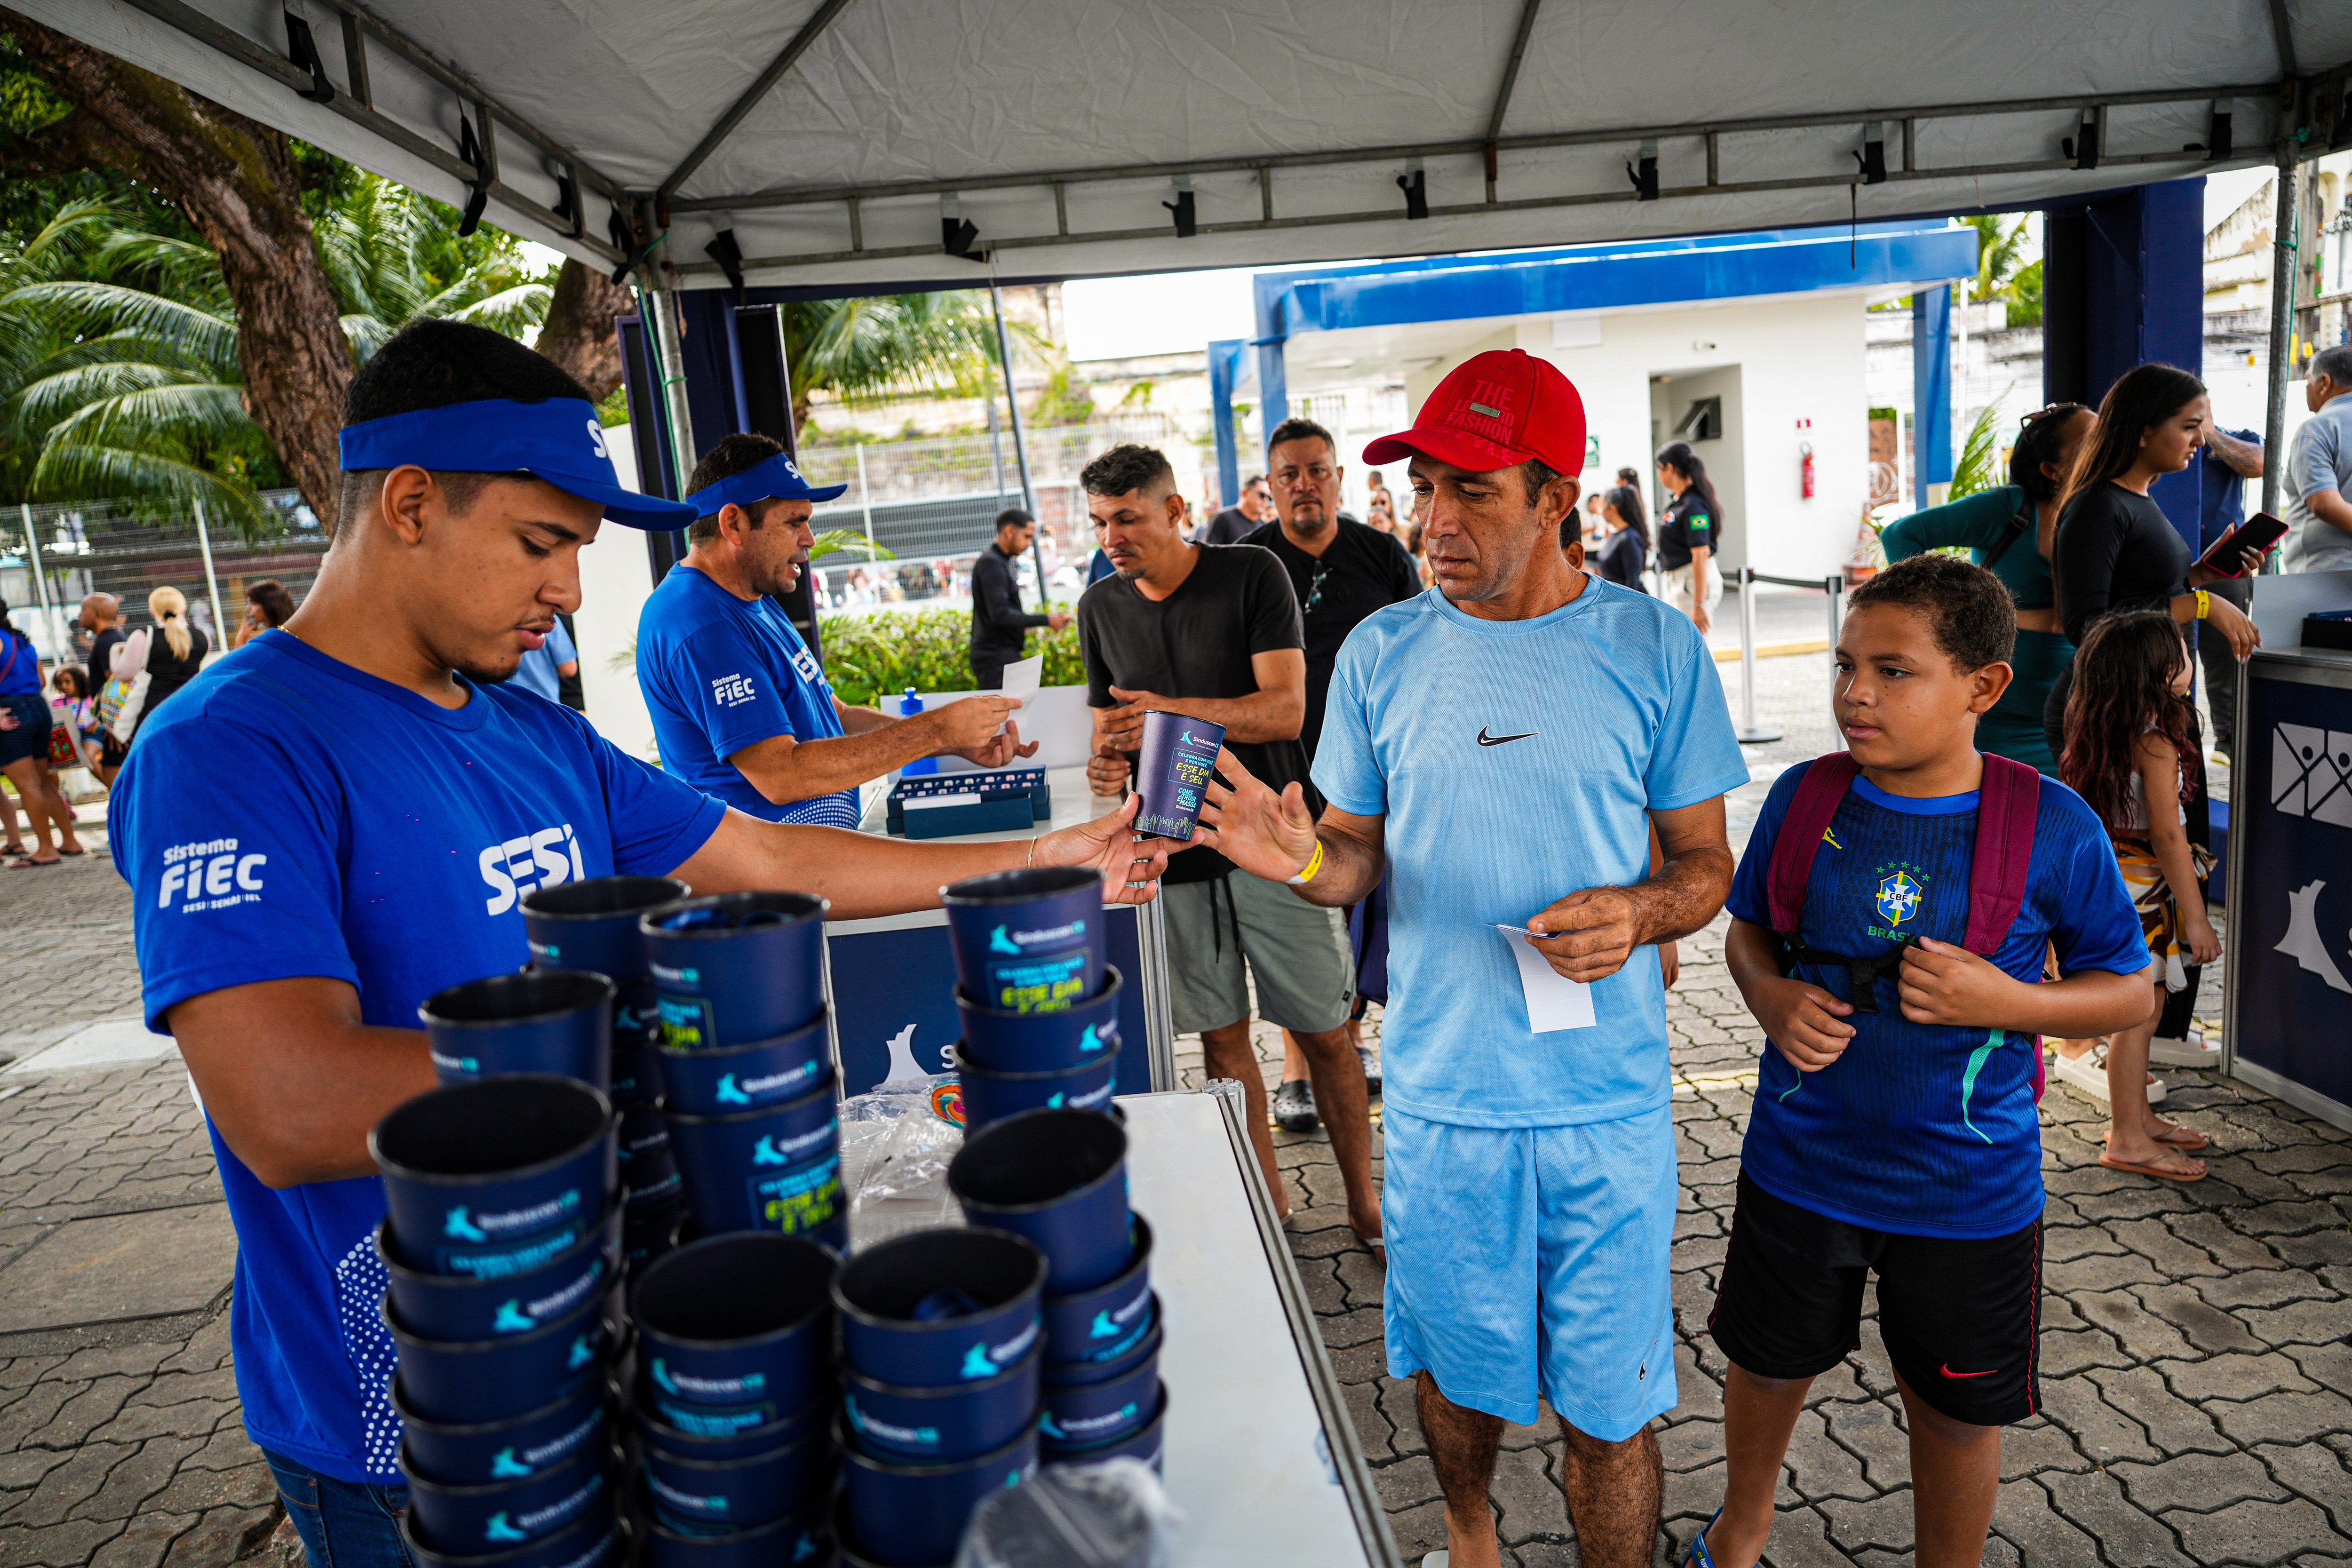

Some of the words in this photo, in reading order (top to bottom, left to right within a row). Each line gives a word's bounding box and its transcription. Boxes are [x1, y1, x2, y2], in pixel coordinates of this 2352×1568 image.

[1470, 379, 1515, 411] THE
[1444, 412, 1512, 445] FASHION
[712, 673, 740, 687] Sistema
[1176, 762, 1198, 774] ESSE
[1199, 768, 1209, 778] DIA
[1178, 788, 1194, 796] CONS
[163, 838, 238, 866] Sistema
[1889, 892, 1908, 902] CBF
